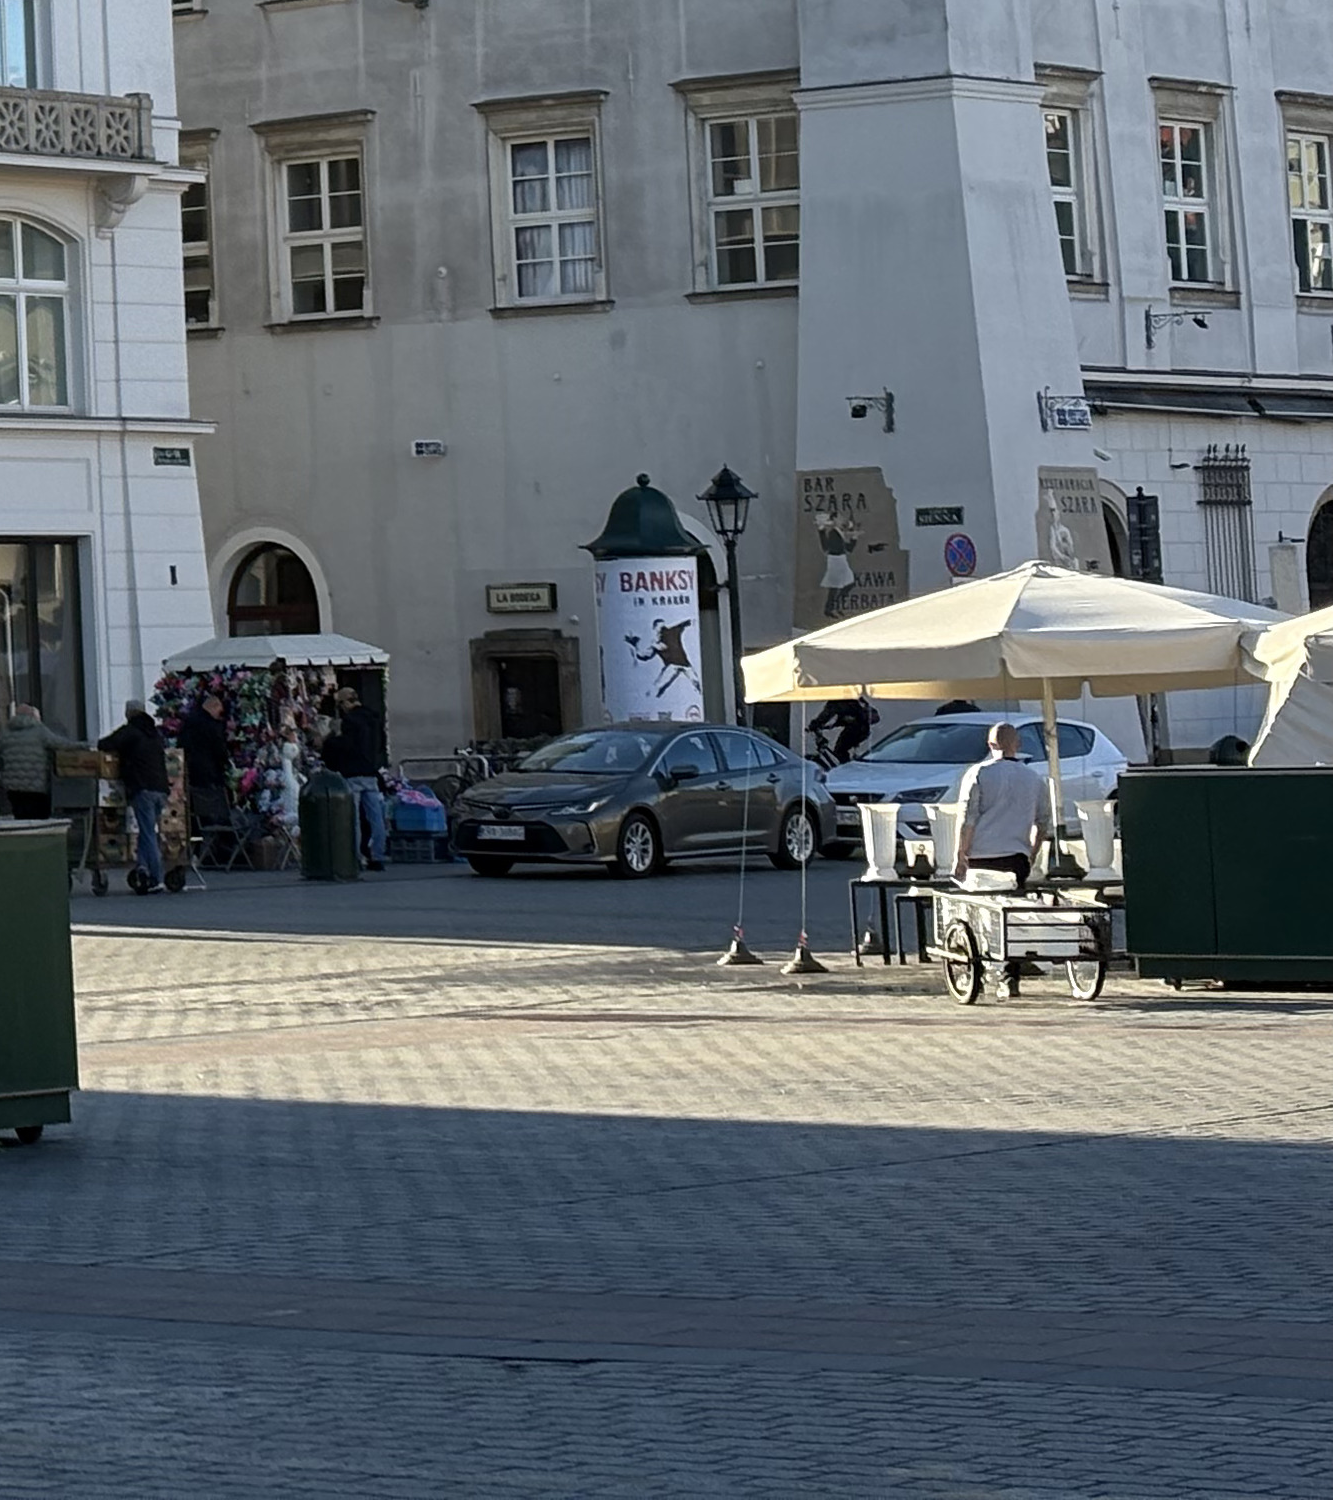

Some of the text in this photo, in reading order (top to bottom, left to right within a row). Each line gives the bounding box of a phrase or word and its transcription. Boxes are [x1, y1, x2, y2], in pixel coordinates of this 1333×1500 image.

[803, 477, 835, 493] BAR
[803, 492, 868, 513] SZARA
[1060, 496, 1098, 514] SZARA
[619, 569, 694, 593] BANKSY
[852, 570, 896, 588] KAWA
[496, 593, 509, 603] LA
